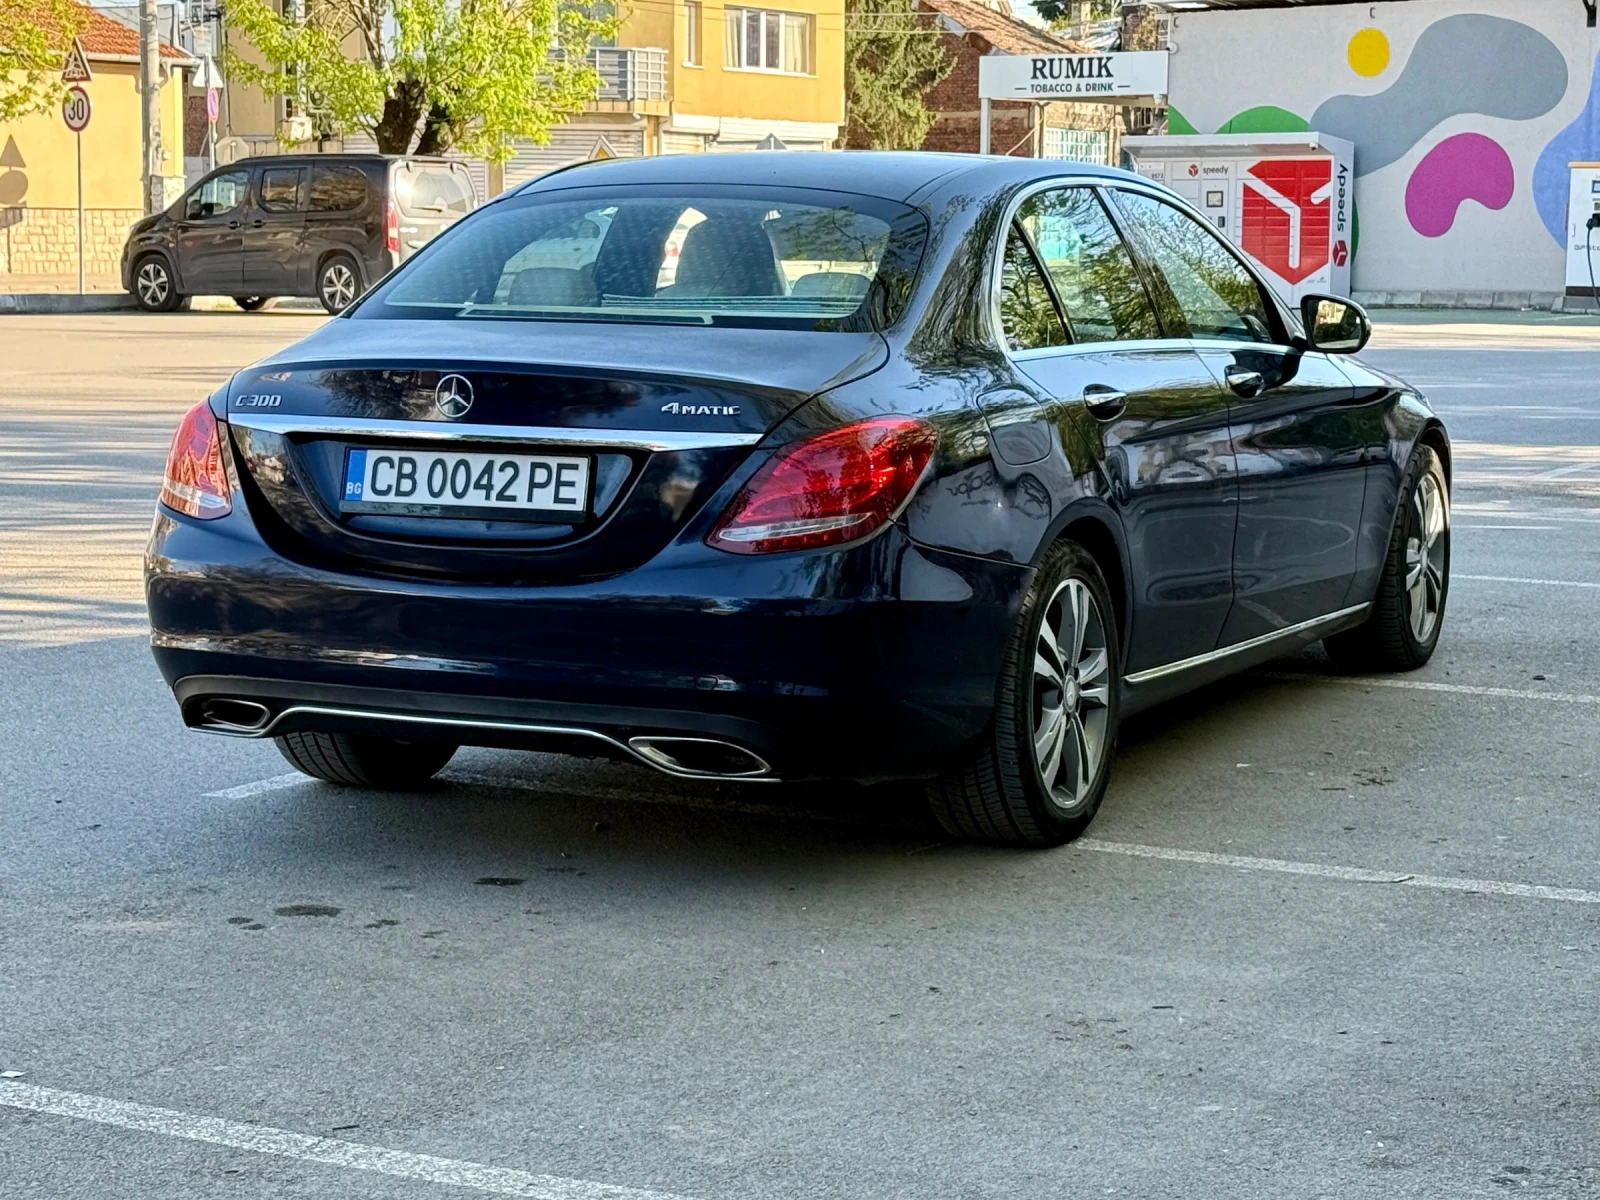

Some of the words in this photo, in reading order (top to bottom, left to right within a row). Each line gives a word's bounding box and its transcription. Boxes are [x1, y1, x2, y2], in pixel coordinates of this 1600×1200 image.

[1030, 56, 1114, 80] RUMIK
[1031, 84, 1073, 94] TOBACCO
[1076, 84, 1082, 93] &
[1085, 82, 1114, 93] DRINK
[68, 98, 85, 121] 30
[1202, 165, 1228, 175] speedy
[1337, 163, 1349, 232] speedy
[660, 402, 741, 416] 4MATIC
[346, 481, 362, 495] BG
[370, 456, 419, 498] CB
[427, 458, 521, 503] 0042
[527, 461, 580, 505] PE
